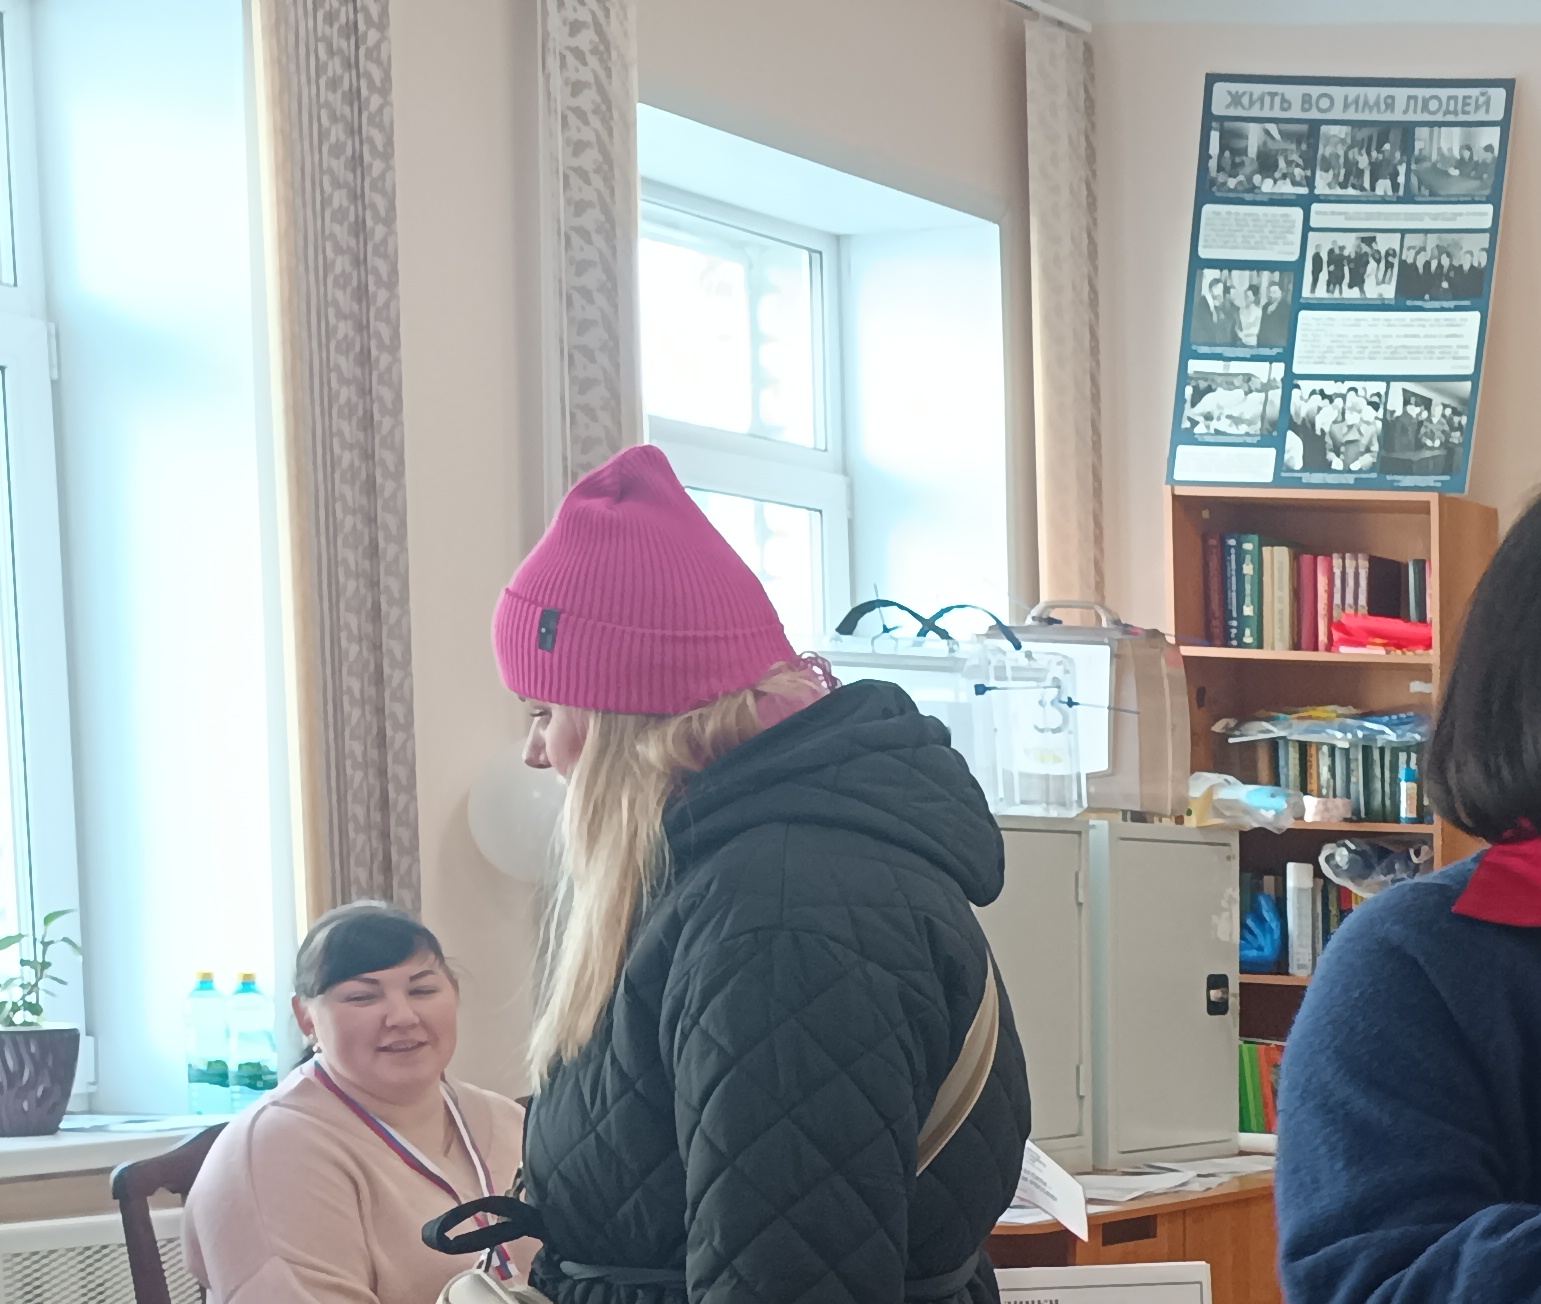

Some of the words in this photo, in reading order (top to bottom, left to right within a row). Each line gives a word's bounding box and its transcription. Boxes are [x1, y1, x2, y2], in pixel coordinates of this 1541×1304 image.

[1224, 89, 1293, 112] ЖИТЬ
[1300, 92, 1336, 114] ВО
[1342, 92, 1396, 115] ИМЯ
[1402, 89, 1493, 118] ЛЮДЕЙ
